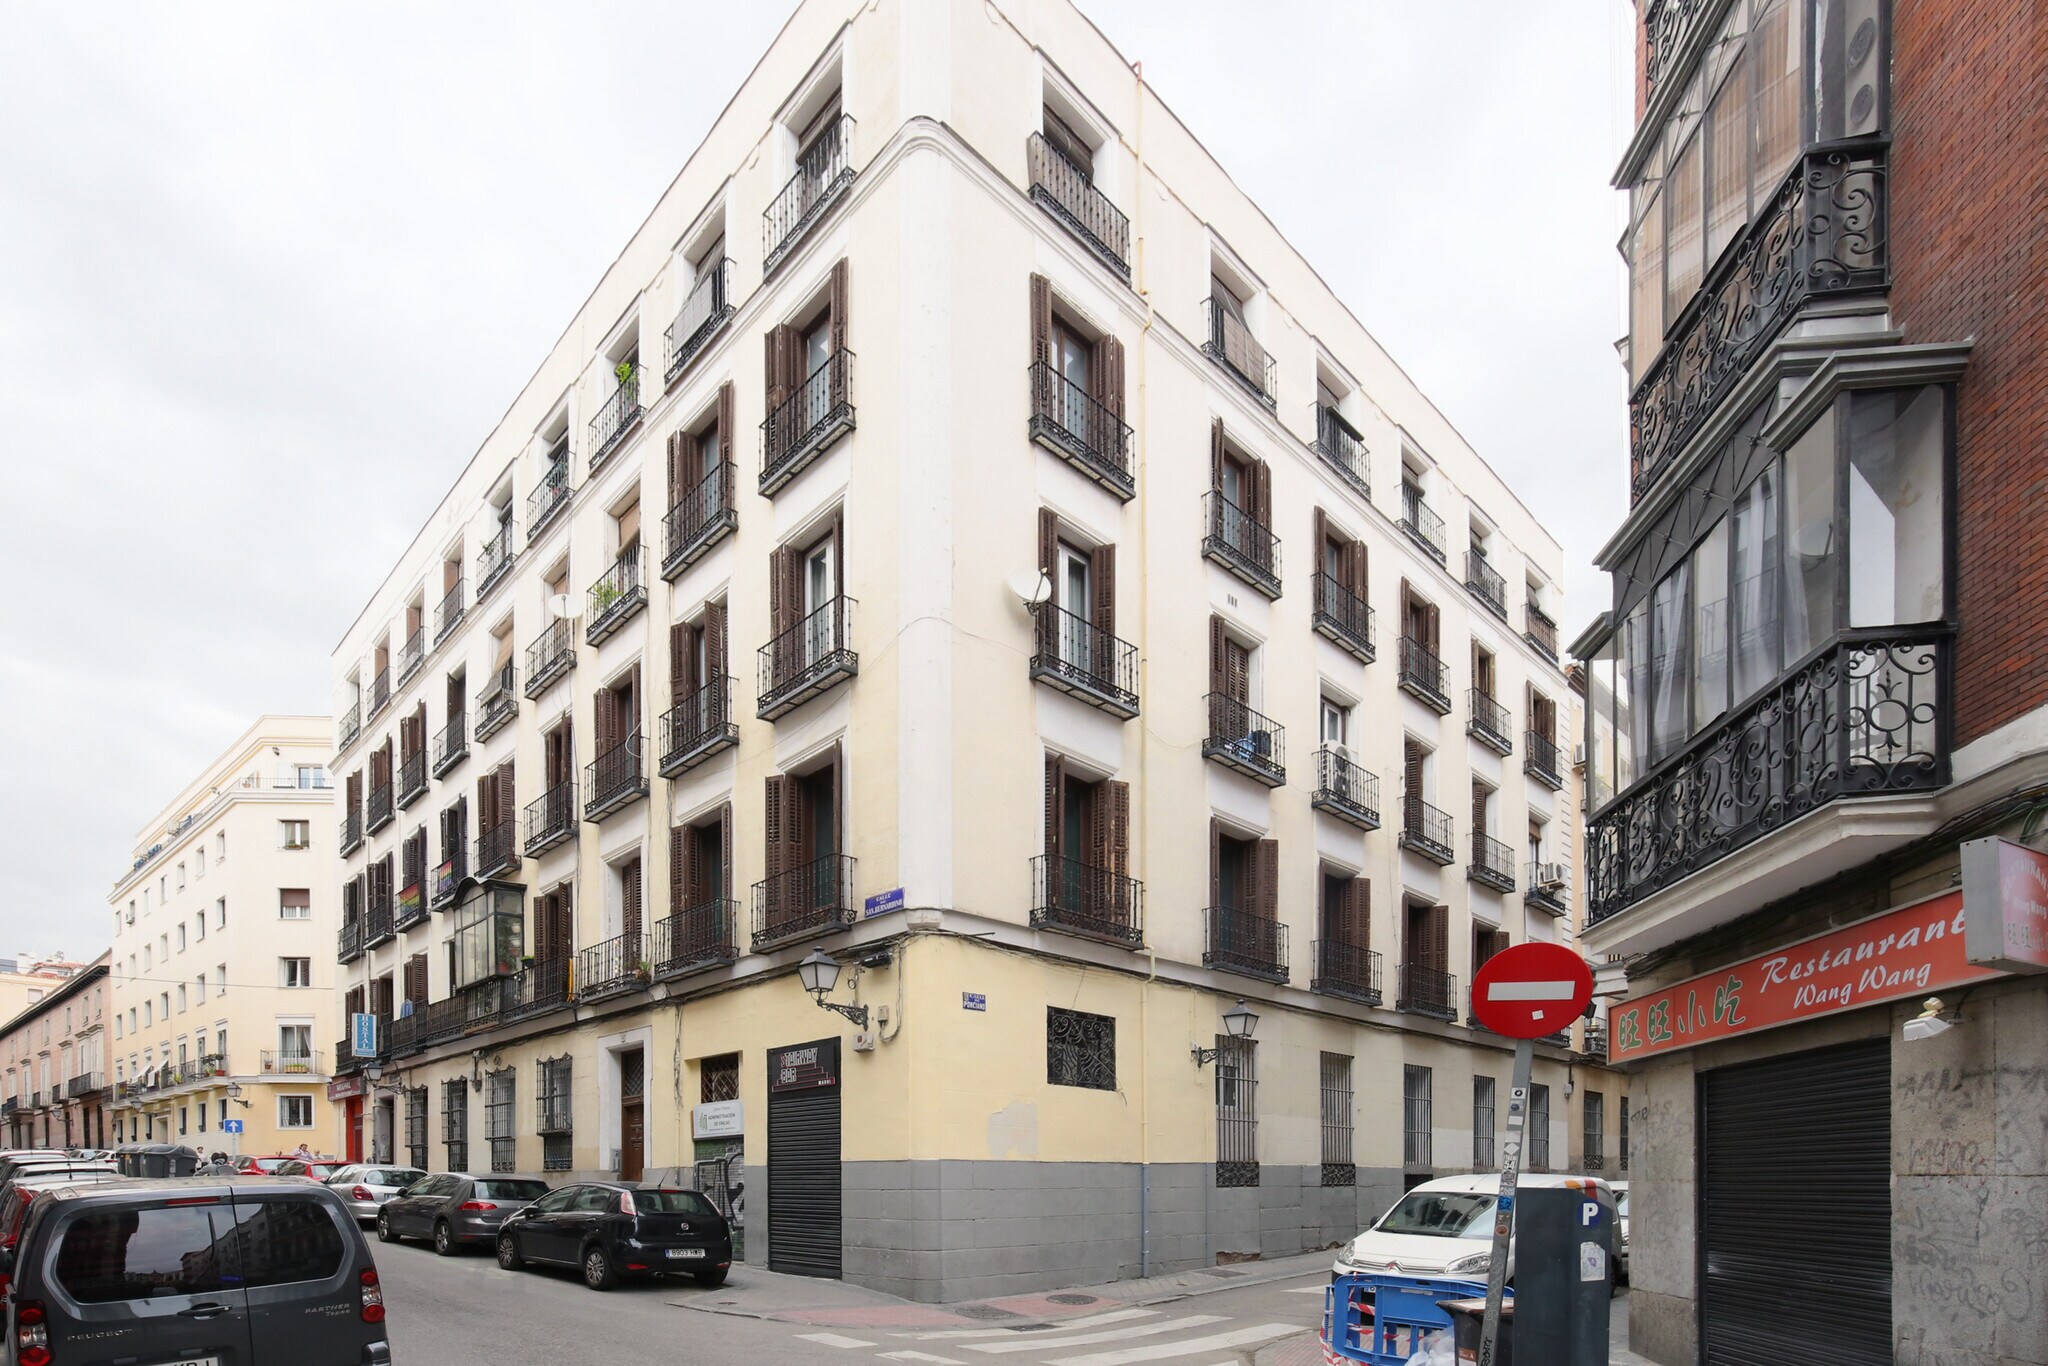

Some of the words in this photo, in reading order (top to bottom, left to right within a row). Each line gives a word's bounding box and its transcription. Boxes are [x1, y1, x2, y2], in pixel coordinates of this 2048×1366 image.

[876, 892, 891, 901] CALLE
[1760, 908, 1966, 993] Restaurant
[1793, 982, 1852, 1009] Wang
[1858, 963, 1931, 993] Wang
[1617, 974, 1747, 1053] 旺旺小吃
[361, 1015, 369, 1049] HOSTAL
[781, 1047, 818, 1068] STAIRWAY
[781, 1067, 797, 1084] BAR
[1582, 1202, 1599, 1226] P
[305, 1303, 350, 1314] PARTNER
[67, 1329, 132, 1341] PEUGEOT
